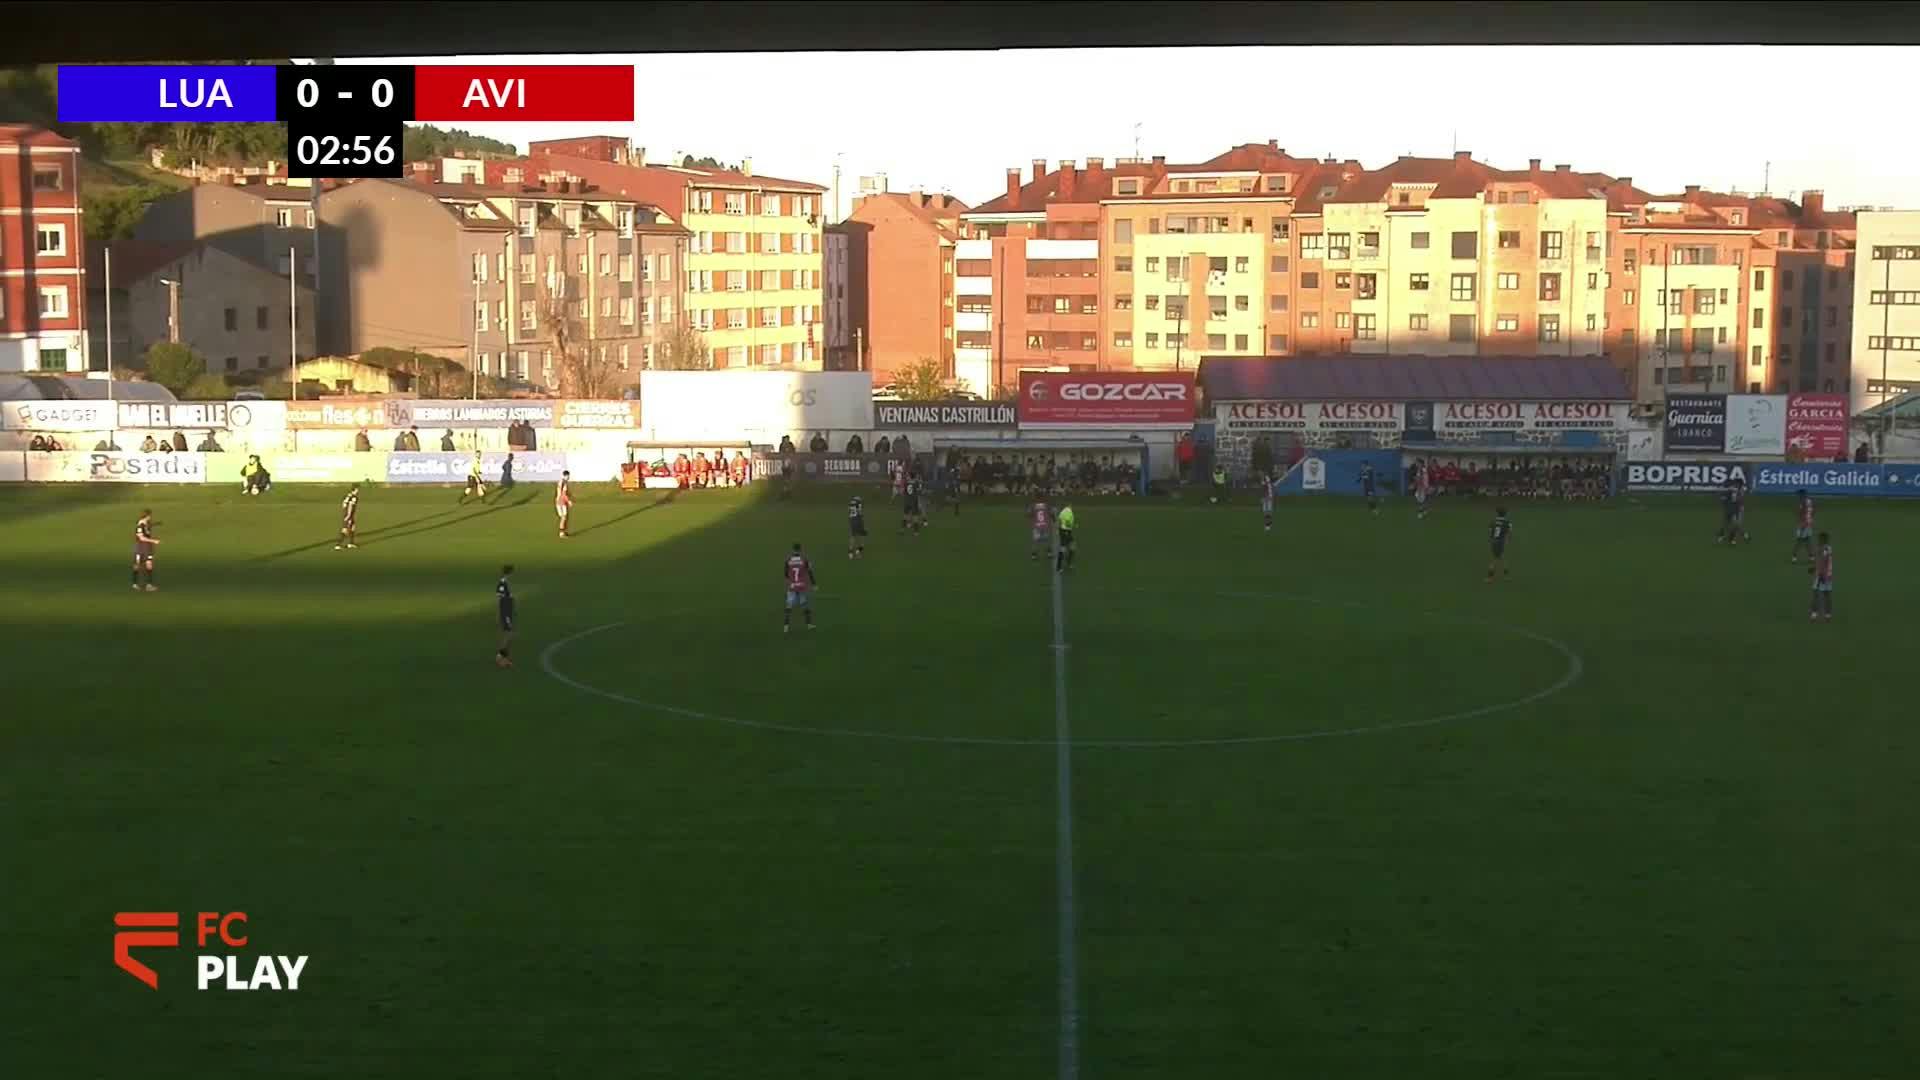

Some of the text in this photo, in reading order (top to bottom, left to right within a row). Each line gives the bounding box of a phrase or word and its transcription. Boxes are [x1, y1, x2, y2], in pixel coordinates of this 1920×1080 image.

[1060, 383, 1186, 400] GOZCAR
[880, 405, 1015, 424] VENTANAS CASTRILLÓN
[1228, 403, 1306, 420] ACESOL
[1319, 403, 1397, 420] ACESOL
[1446, 403, 1526, 420] ACESOL
[1535, 403, 1614, 419] ACESOL
[1669, 411, 1724, 428] Guernica
[1789, 409, 1844, 417] GARCIA
[1680, 429, 1713, 438] LUANCO
[90, 454, 198, 475] Posada
[1628, 465, 1746, 484] BOPRISA
[1760, 469, 1820, 485] Estrella
[1824, 470, 1880, 486] Galicia
